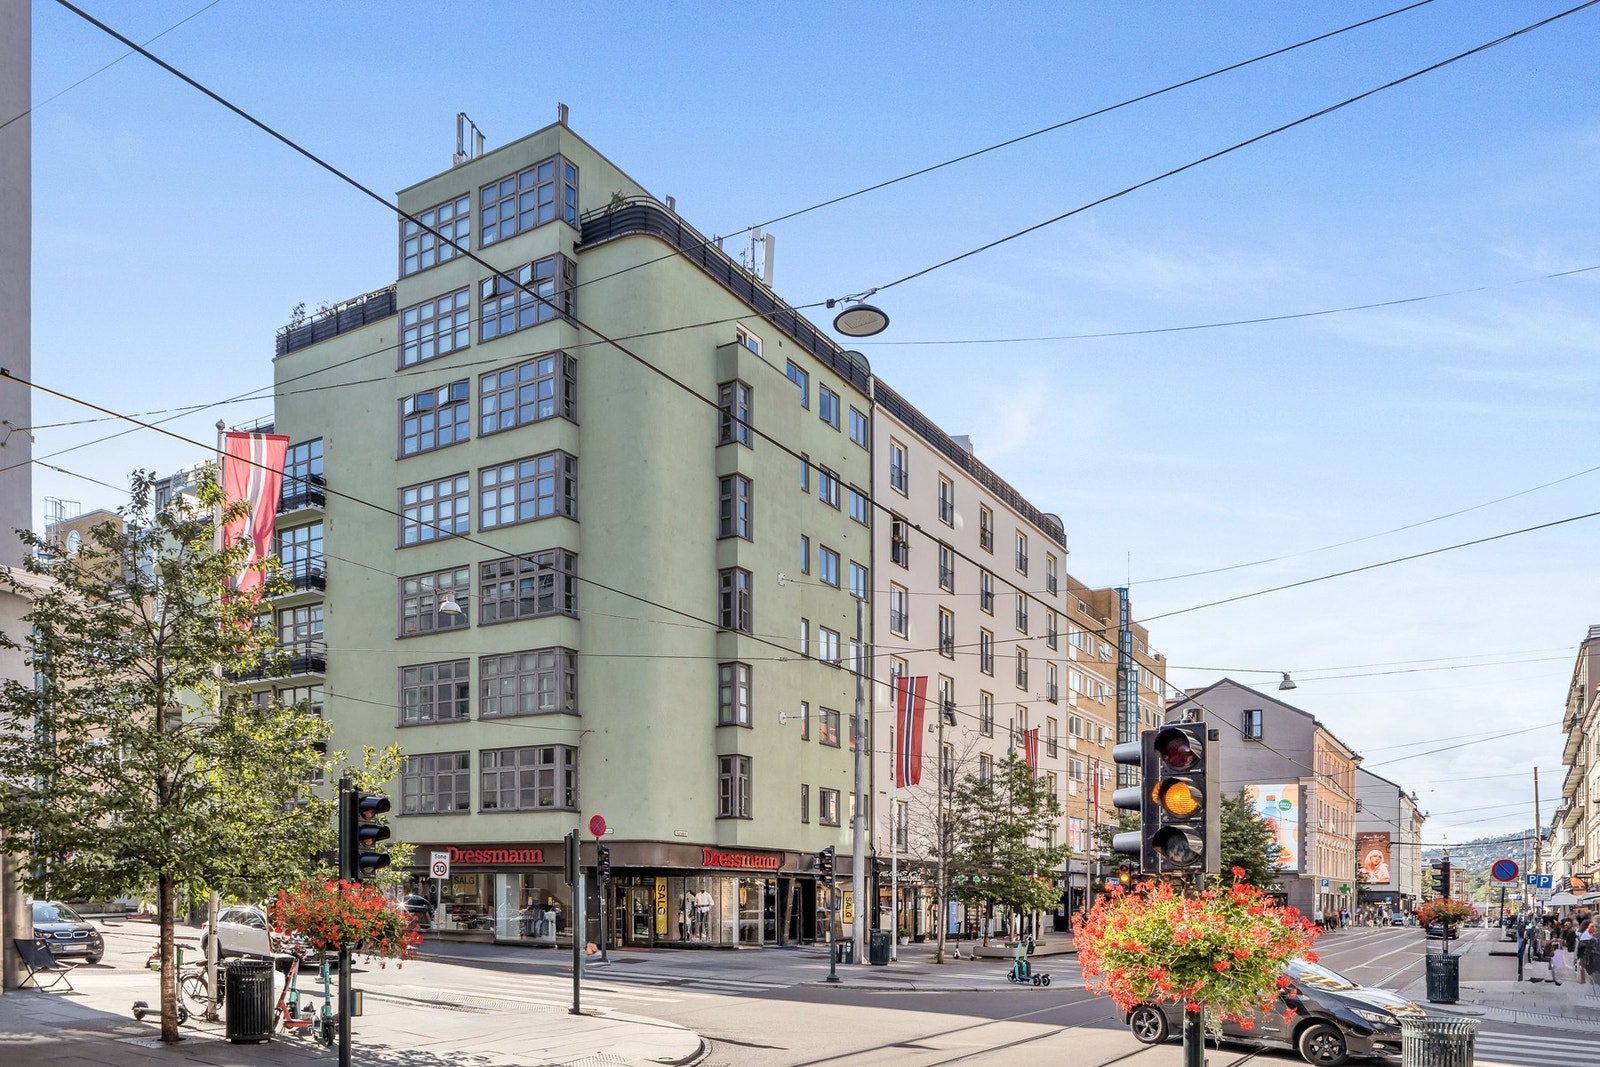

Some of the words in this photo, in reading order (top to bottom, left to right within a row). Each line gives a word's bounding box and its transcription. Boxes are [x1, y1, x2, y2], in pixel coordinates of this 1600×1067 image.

[447, 847, 543, 864] Dressmann
[702, 848, 778, 868] Dressmann
[435, 864, 445, 873] 30
[454, 876, 474, 884] SALG
[1540, 876, 1549, 886] P
[657, 884, 666, 915] SALG
